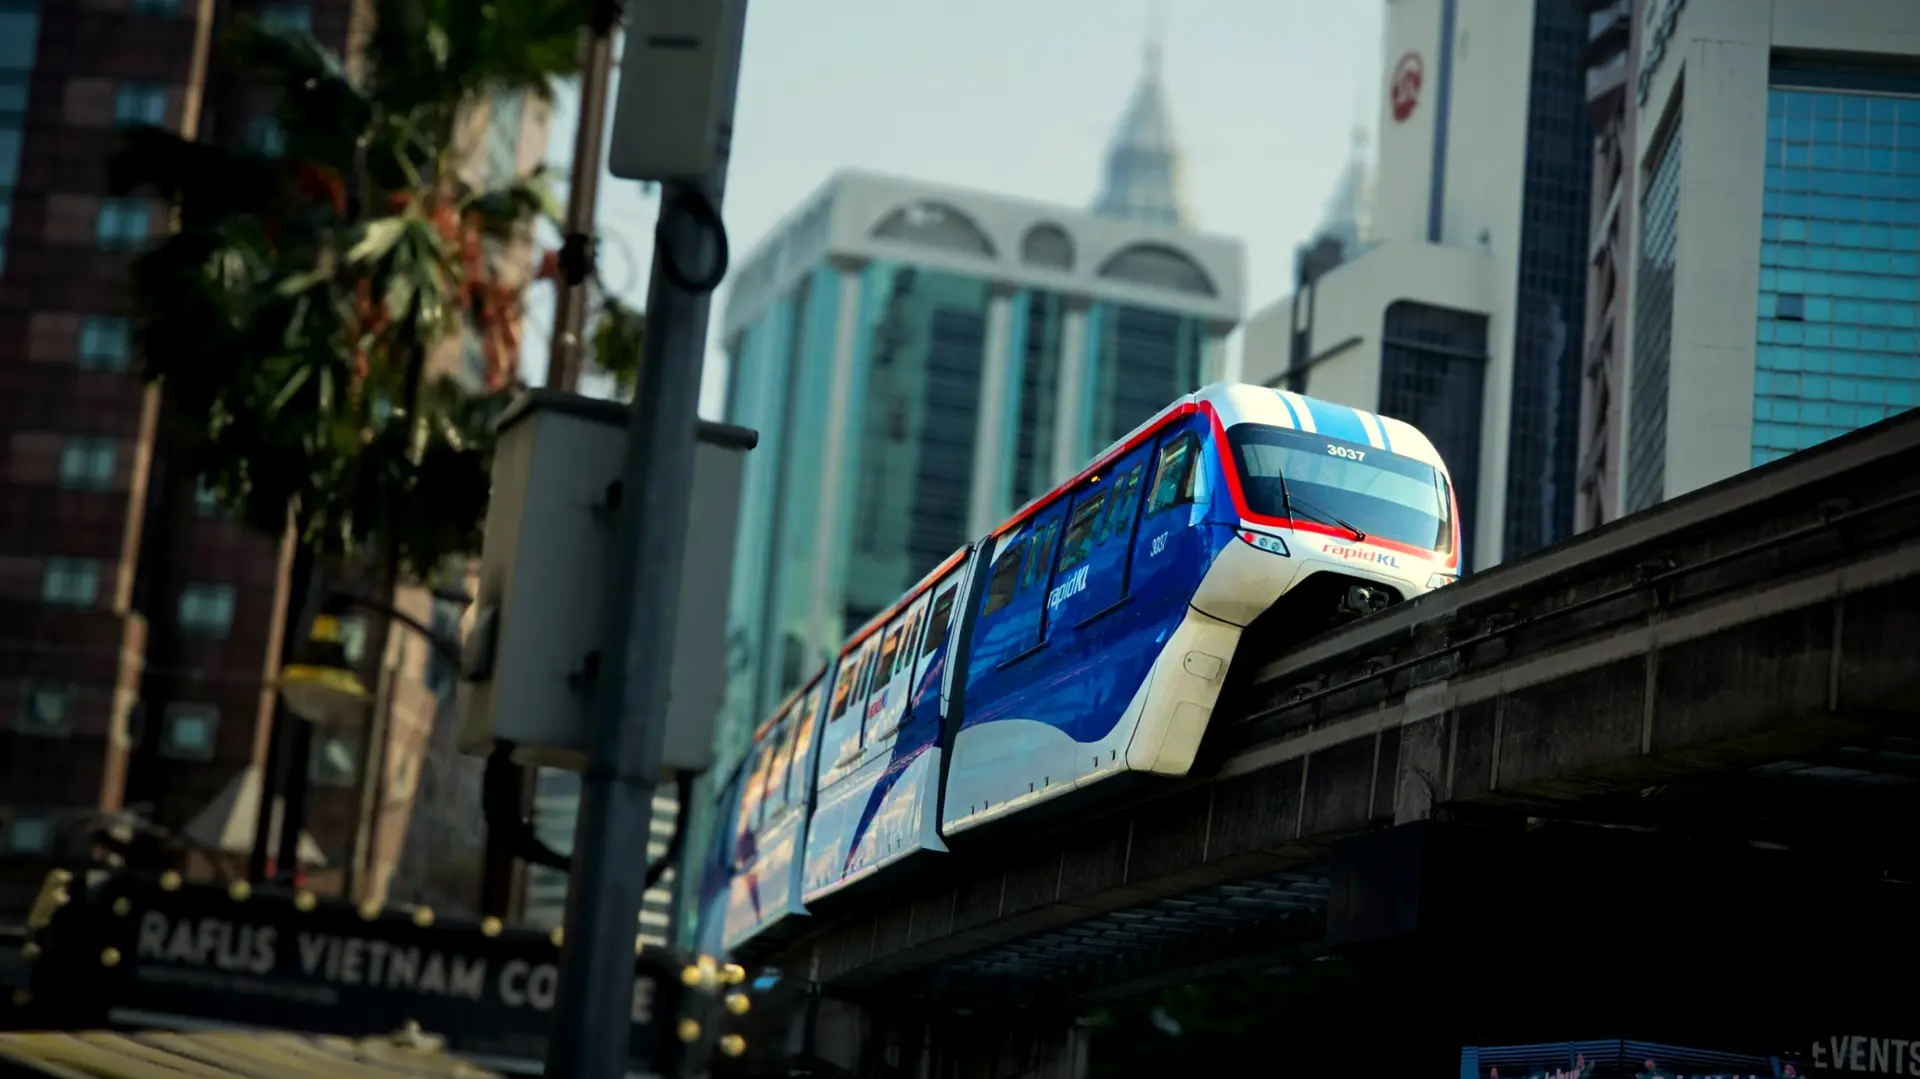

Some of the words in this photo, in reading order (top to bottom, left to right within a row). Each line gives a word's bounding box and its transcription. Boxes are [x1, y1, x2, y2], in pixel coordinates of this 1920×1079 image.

[1326, 444, 1366, 462] 3037
[1149, 531, 1169, 558] 3037
[1320, 543, 1400, 569] rapidKL
[1047, 564, 1090, 610] rapidKL
[296, 929, 490, 1002] VIETNAM
